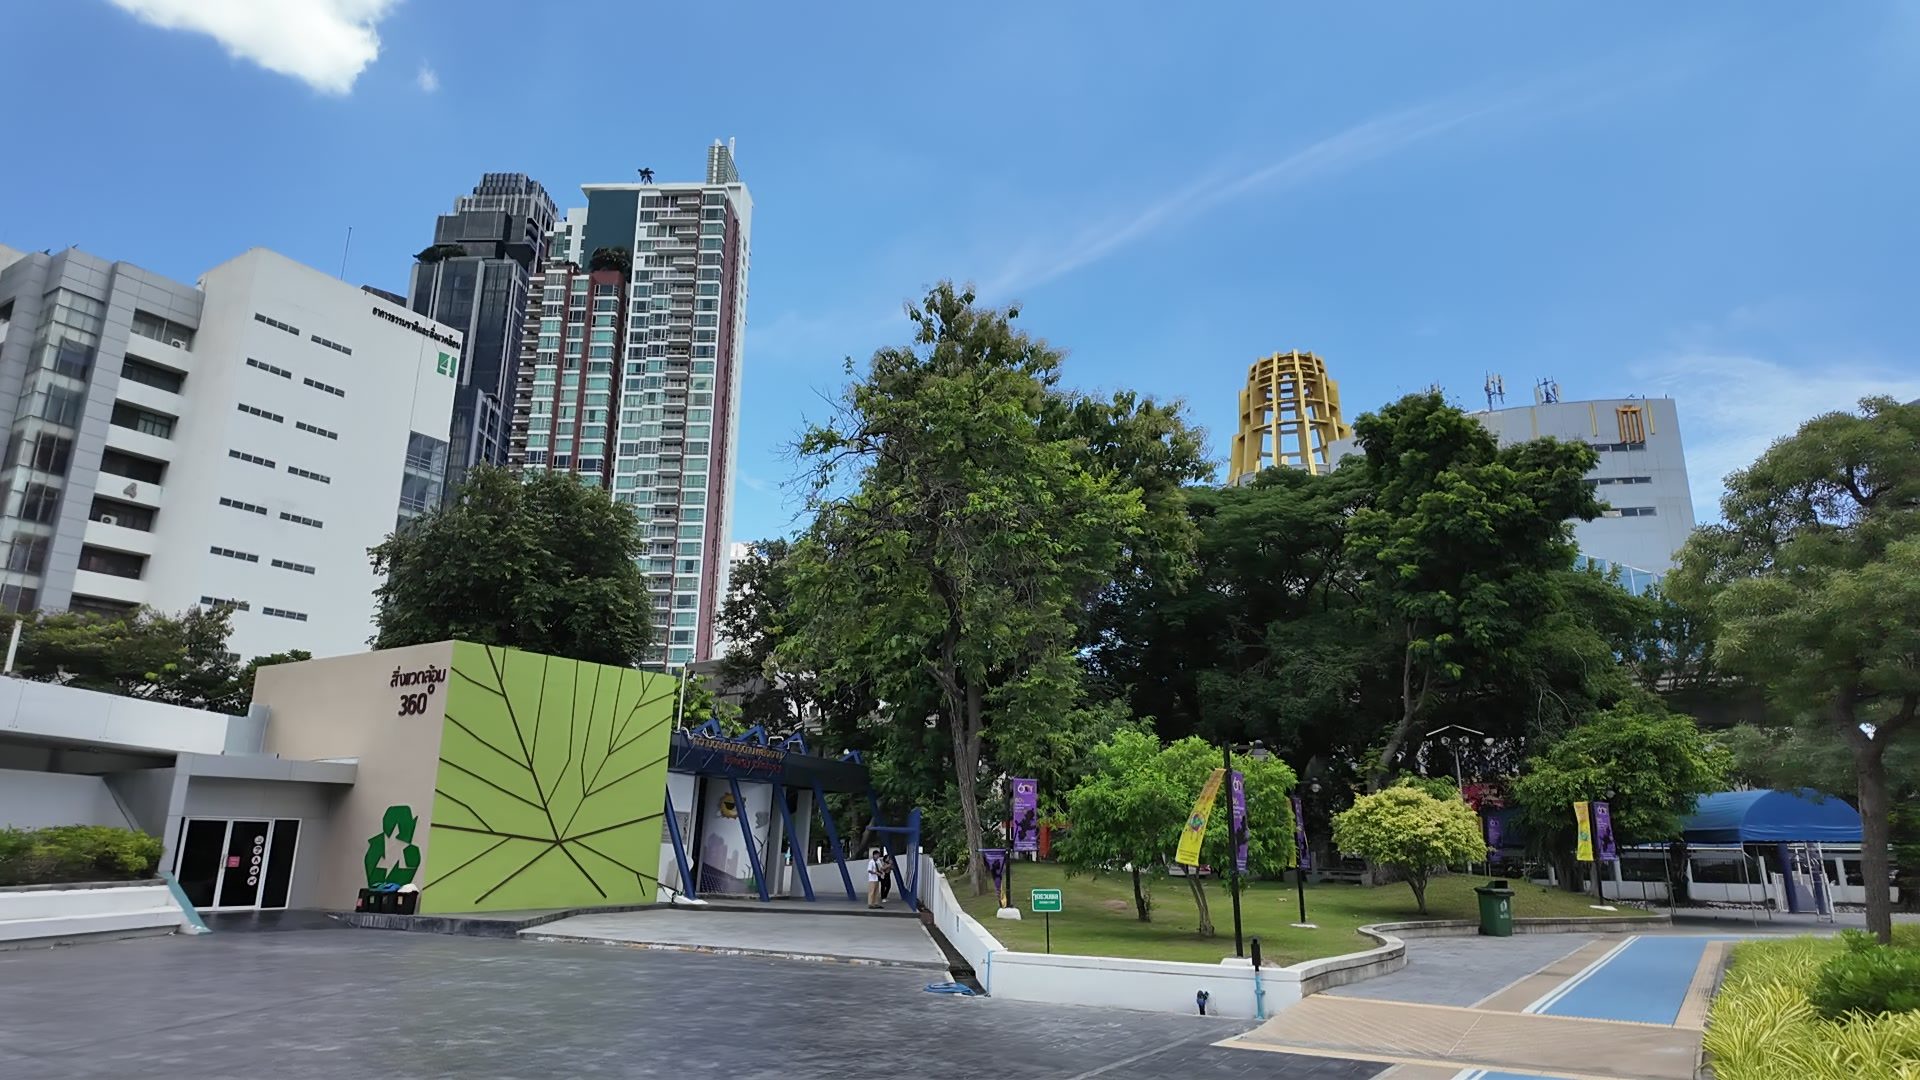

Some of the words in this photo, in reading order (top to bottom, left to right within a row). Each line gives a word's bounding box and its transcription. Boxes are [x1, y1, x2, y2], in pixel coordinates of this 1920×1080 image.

[390, 664, 447, 688] สิ่งแวดล้อม
